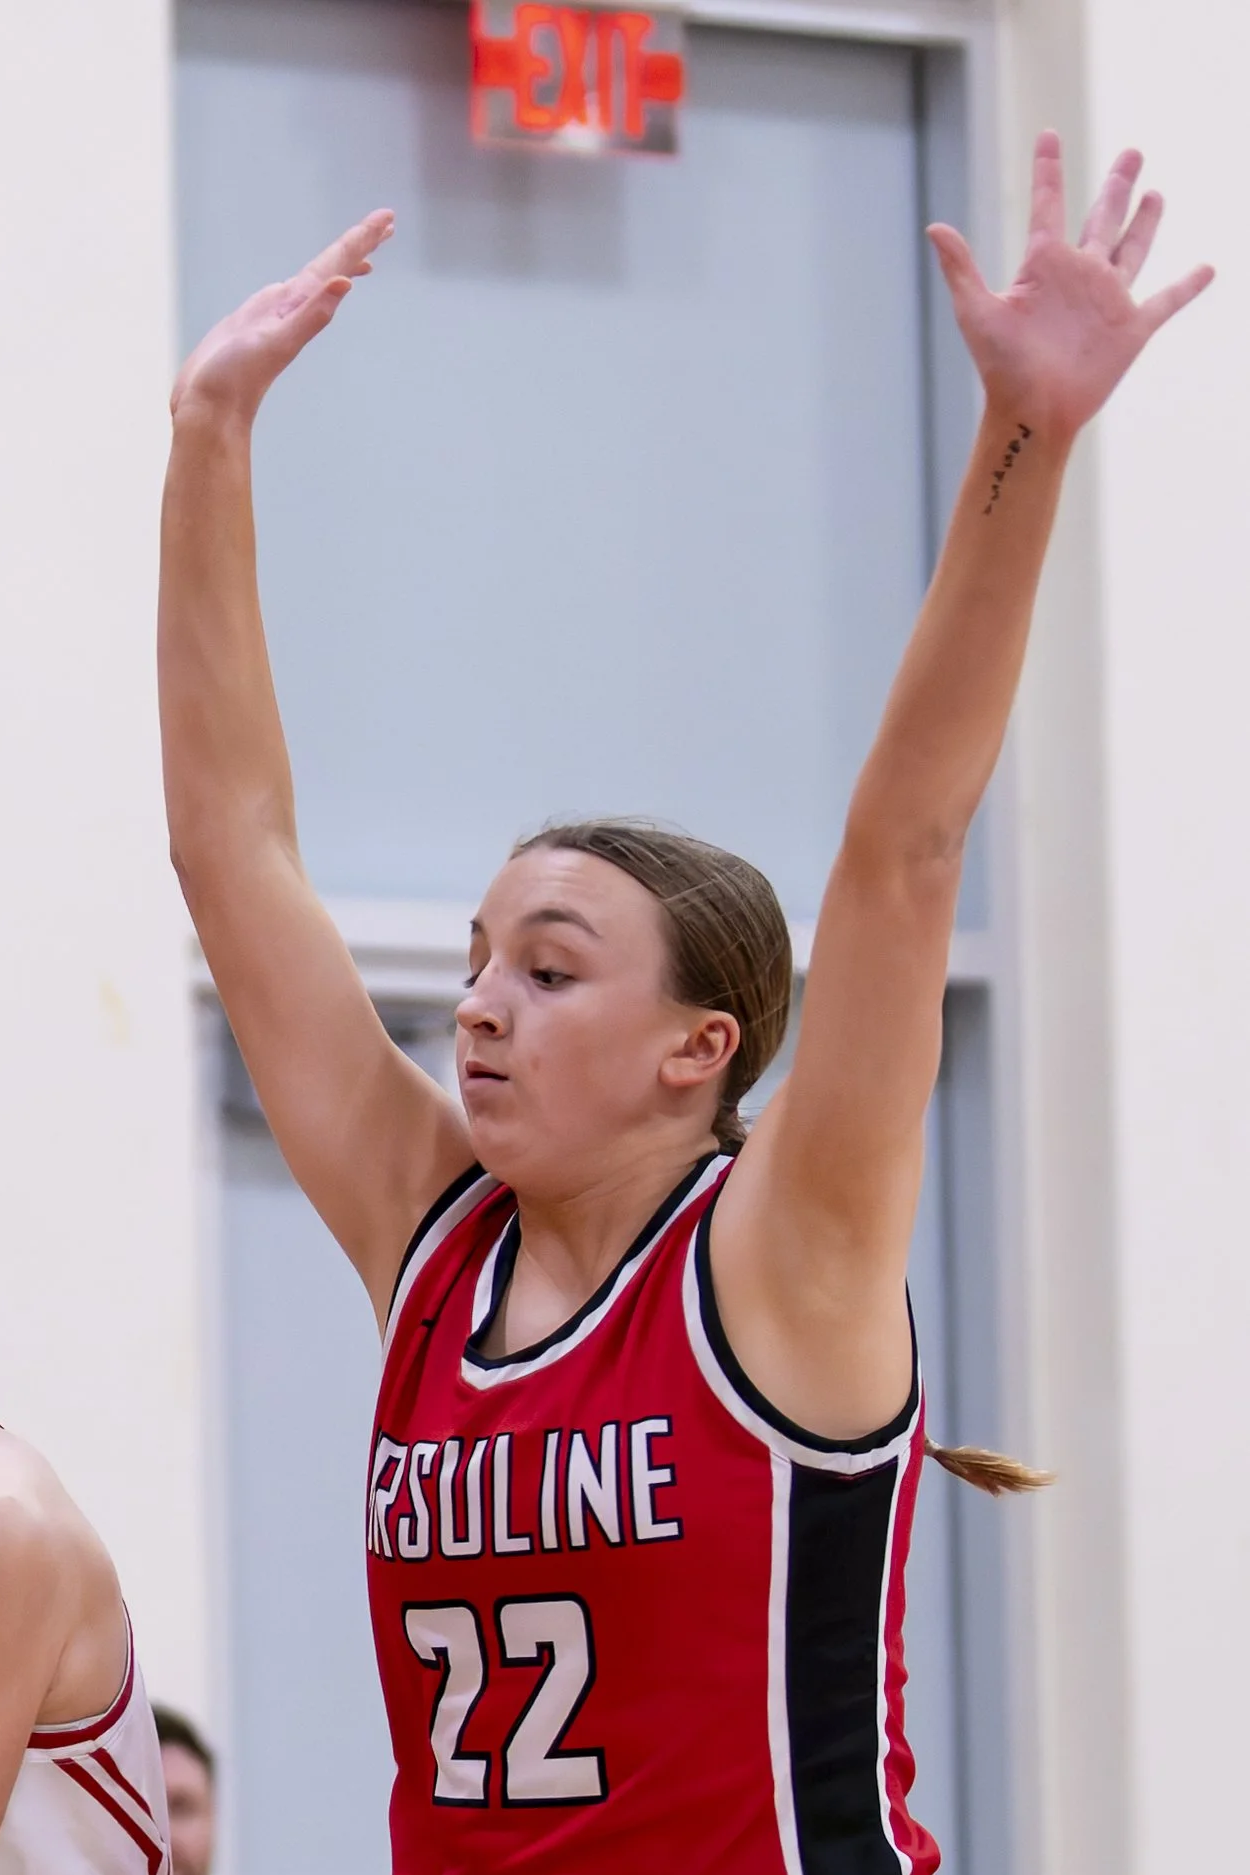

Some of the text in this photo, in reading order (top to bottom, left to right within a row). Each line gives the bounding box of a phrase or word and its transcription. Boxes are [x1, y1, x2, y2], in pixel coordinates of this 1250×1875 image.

[514, 3, 654, 138] EXIT
[366, 1413, 685, 1563] RSULINE
[400, 1592, 609, 1809] 22
